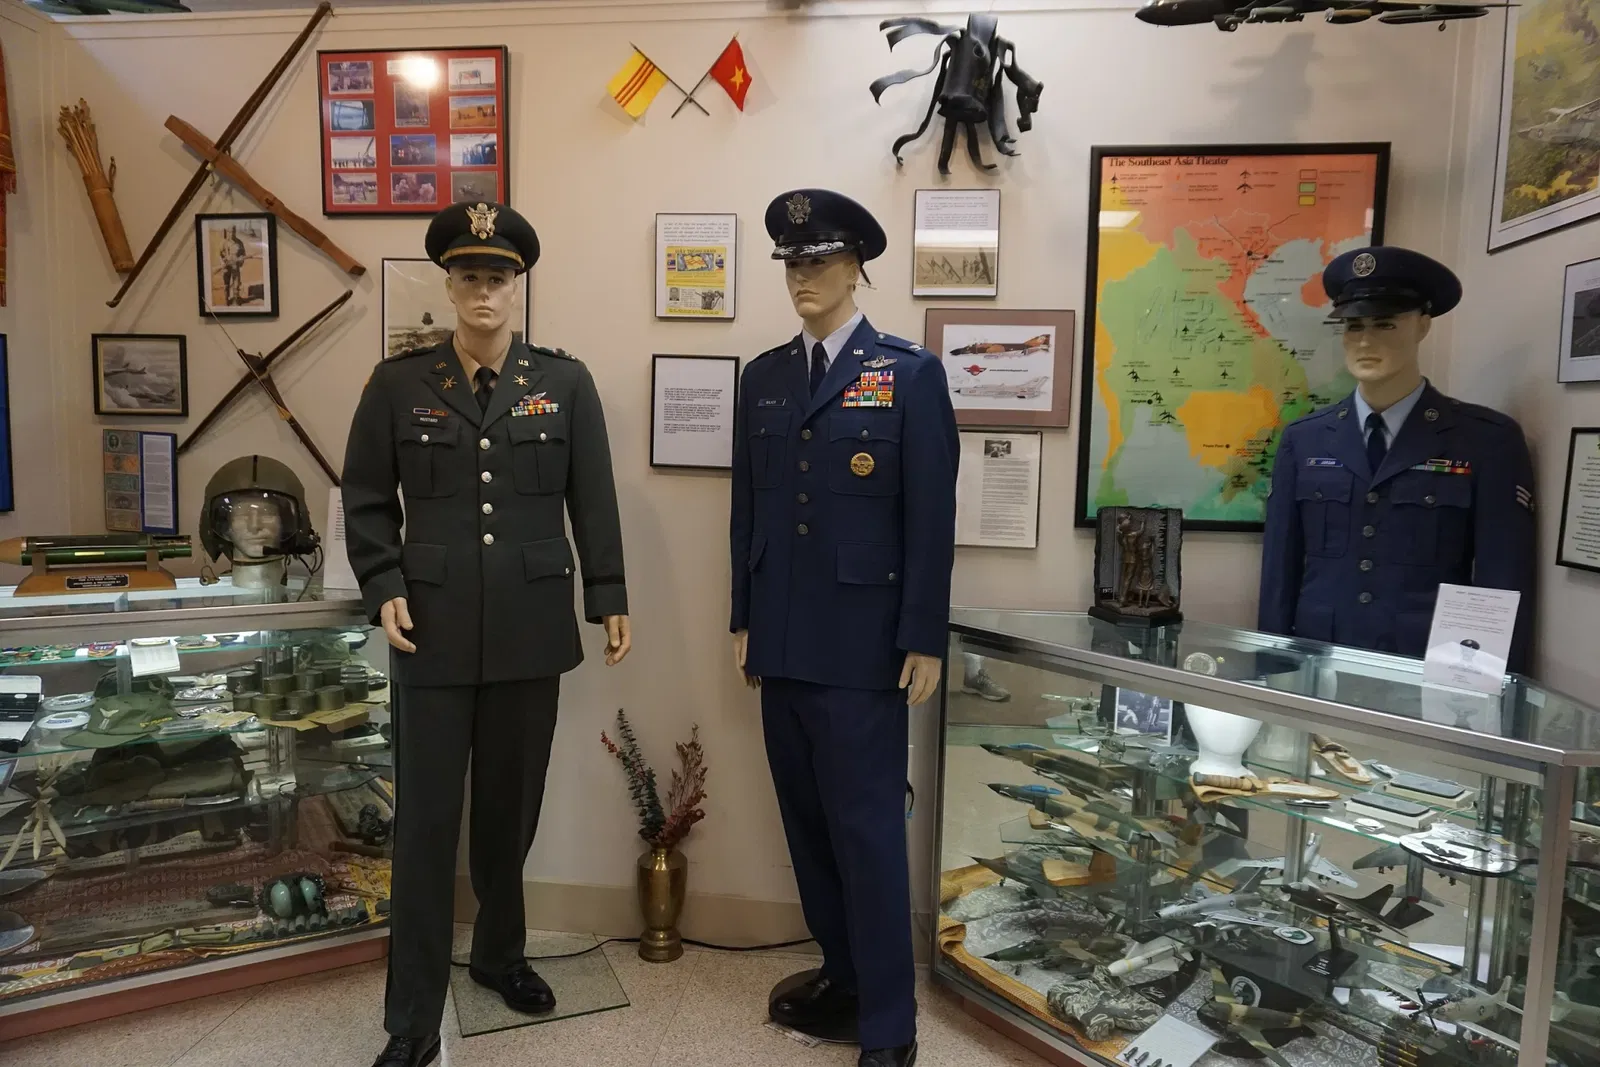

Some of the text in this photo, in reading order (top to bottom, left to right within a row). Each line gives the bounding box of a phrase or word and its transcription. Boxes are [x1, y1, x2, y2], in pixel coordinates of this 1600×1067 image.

[1109, 156, 1230, 166] The Southeast Asia Theater
